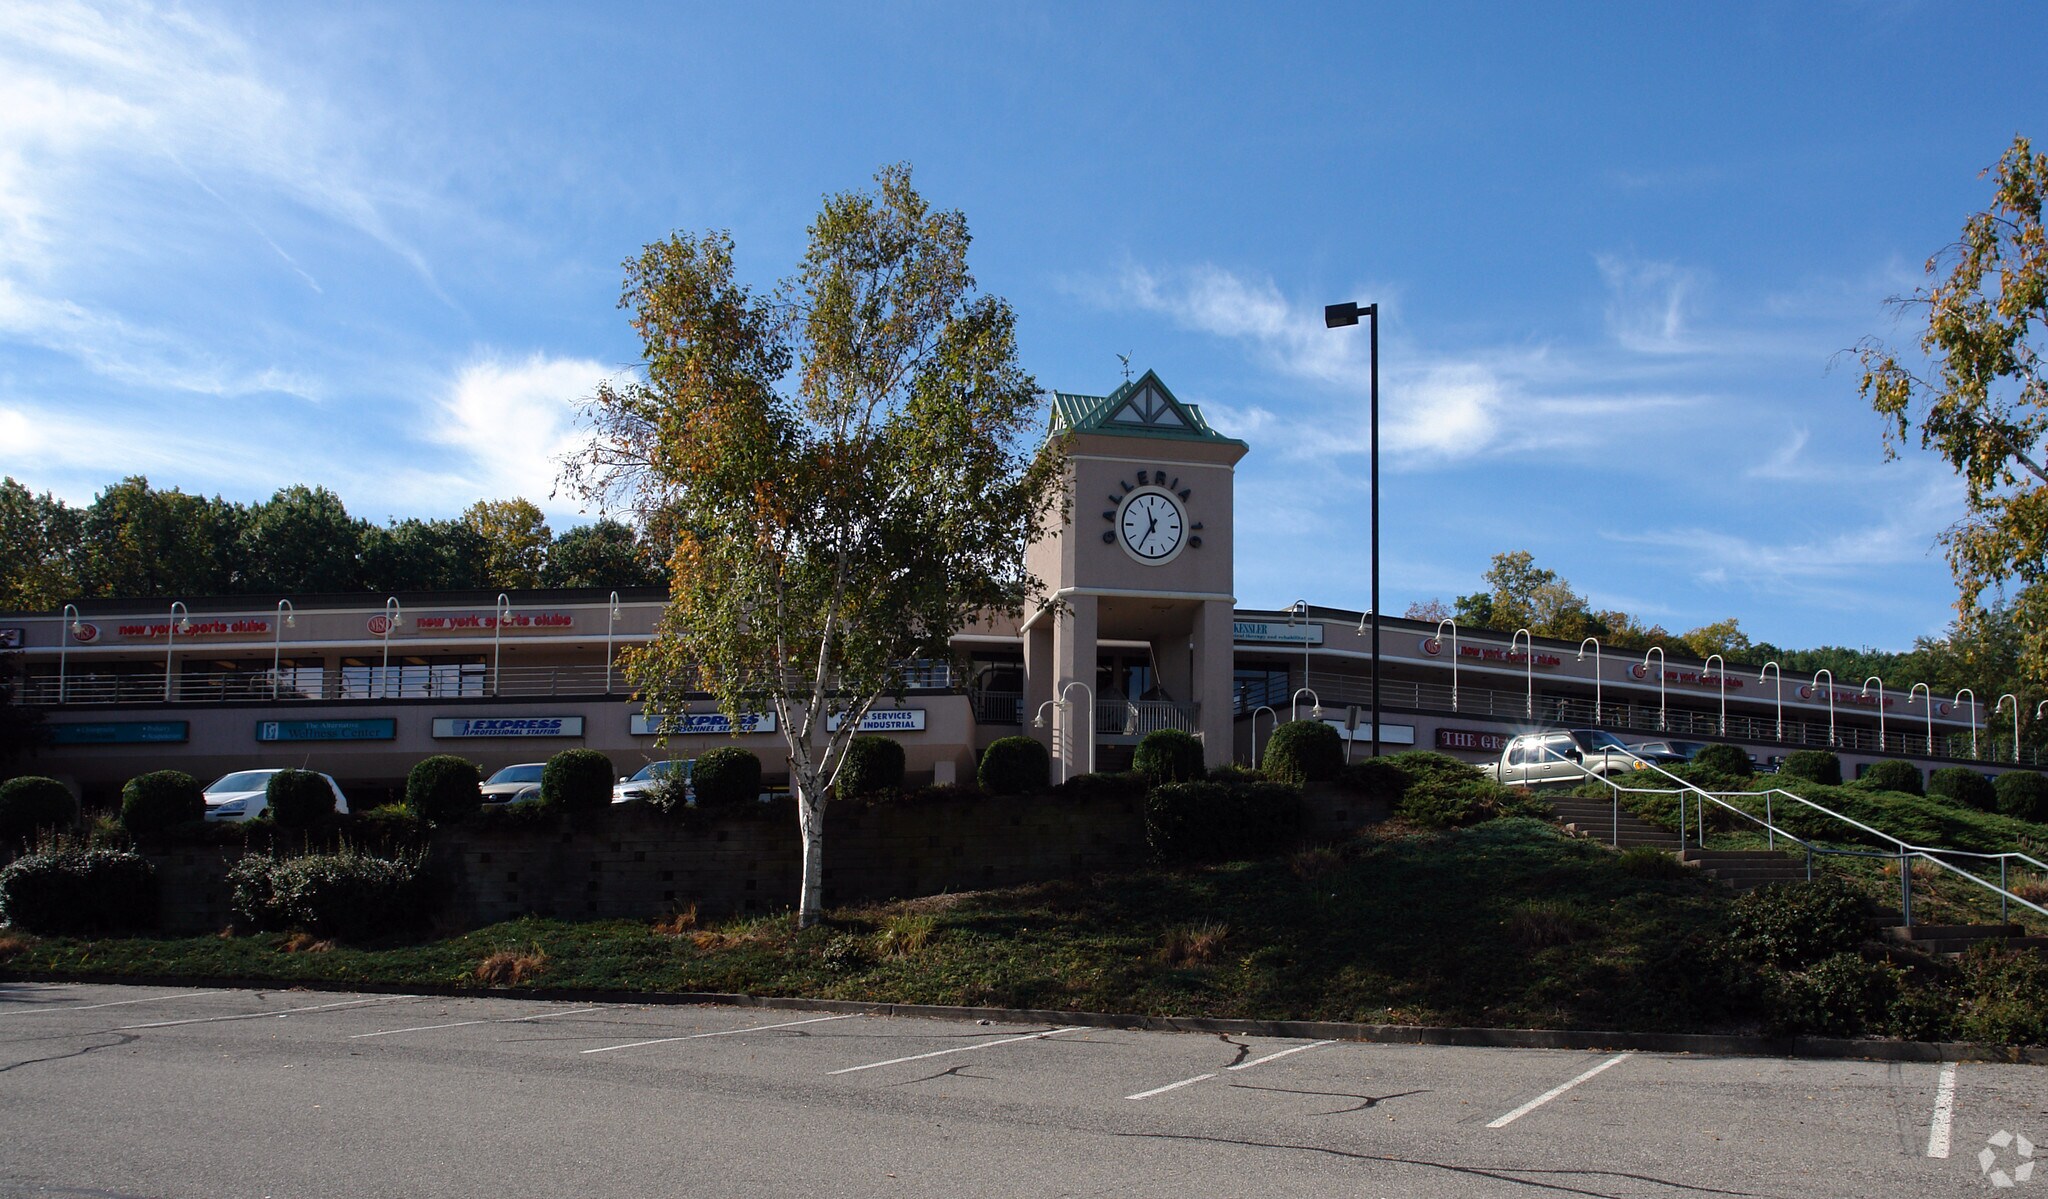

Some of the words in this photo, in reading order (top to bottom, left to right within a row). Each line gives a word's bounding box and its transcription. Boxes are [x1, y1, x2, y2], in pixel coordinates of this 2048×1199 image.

[1102, 470, 1191, 545] GALLERIA
[119, 624, 145, 635] new
[149, 623, 179, 637] york
[231, 619, 268, 632] clubs
[416, 616, 443, 628] new
[449, 615, 479, 631] york
[534, 612, 571, 626] clubs
[1233, 622, 1268, 635] KESSLER
[871, 712, 912, 720] SERVICES
[472, 719, 562, 730] EXPRESS
[863, 721, 916, 729] INDUSTRIAL
[288, 729, 337, 739] Wellness
[341, 729, 381, 738] Center
[1441, 731, 1477, 747] THE
